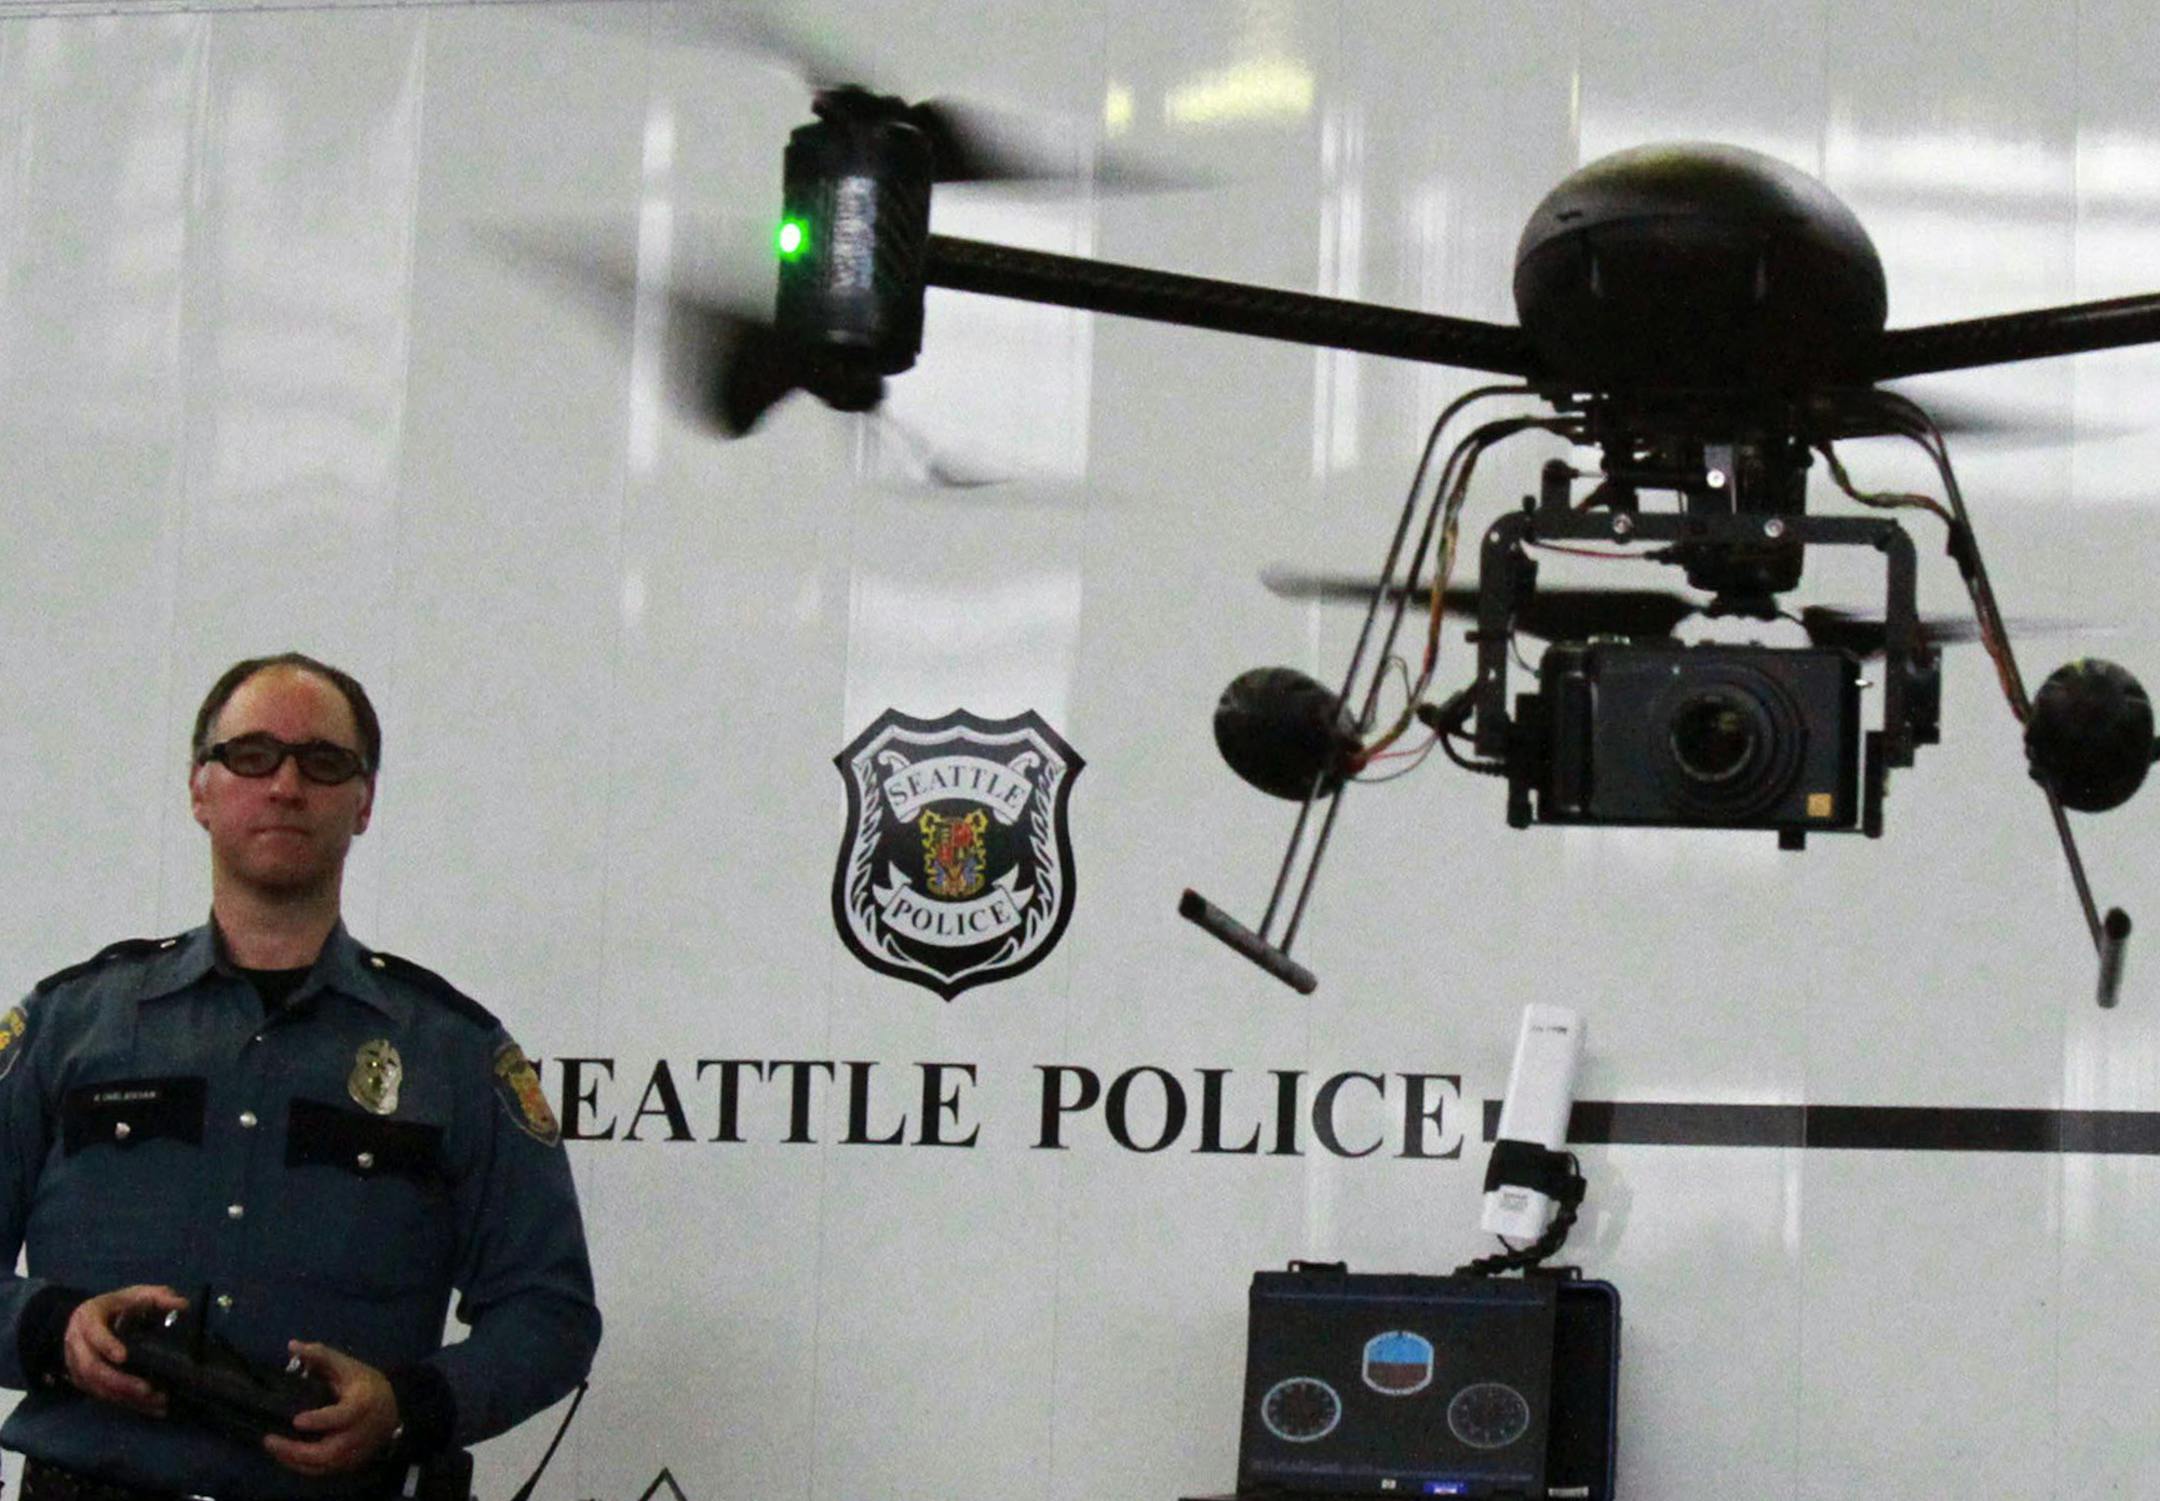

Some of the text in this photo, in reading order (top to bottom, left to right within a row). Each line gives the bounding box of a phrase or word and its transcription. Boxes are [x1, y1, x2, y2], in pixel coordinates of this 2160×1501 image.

[888, 765, 1026, 810] SEATTLE
[892, 898, 1012, 936] POLICE
[529, 1057, 1464, 1160] EATTLE POLICE
